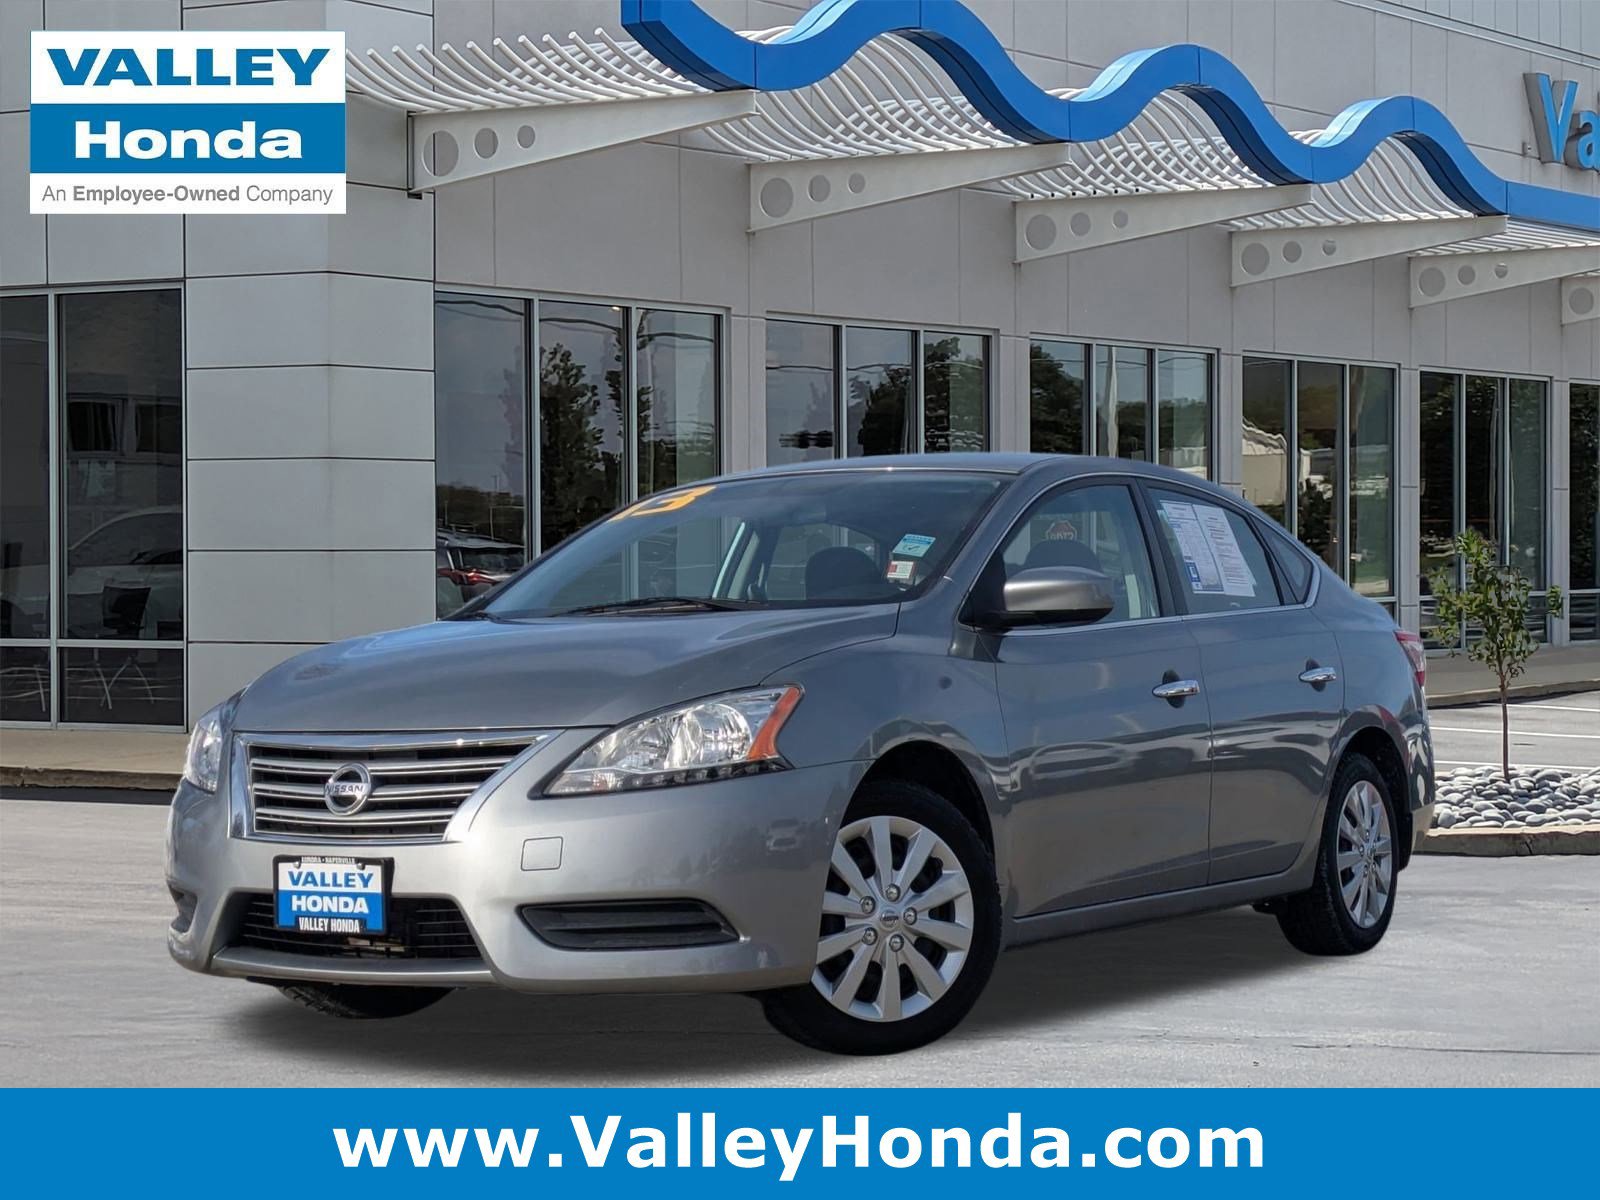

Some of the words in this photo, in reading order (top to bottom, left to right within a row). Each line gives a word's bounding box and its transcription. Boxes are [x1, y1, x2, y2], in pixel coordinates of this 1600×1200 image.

[1523, 72, 1600, 176] Va
[325, 783, 364, 795] NISSAN
[288, 870, 374, 889] VALLEY
[291, 895, 370, 914] HONDA
[298, 916, 329, 932] VALLEY
[330, 918, 361, 933] HONDA
